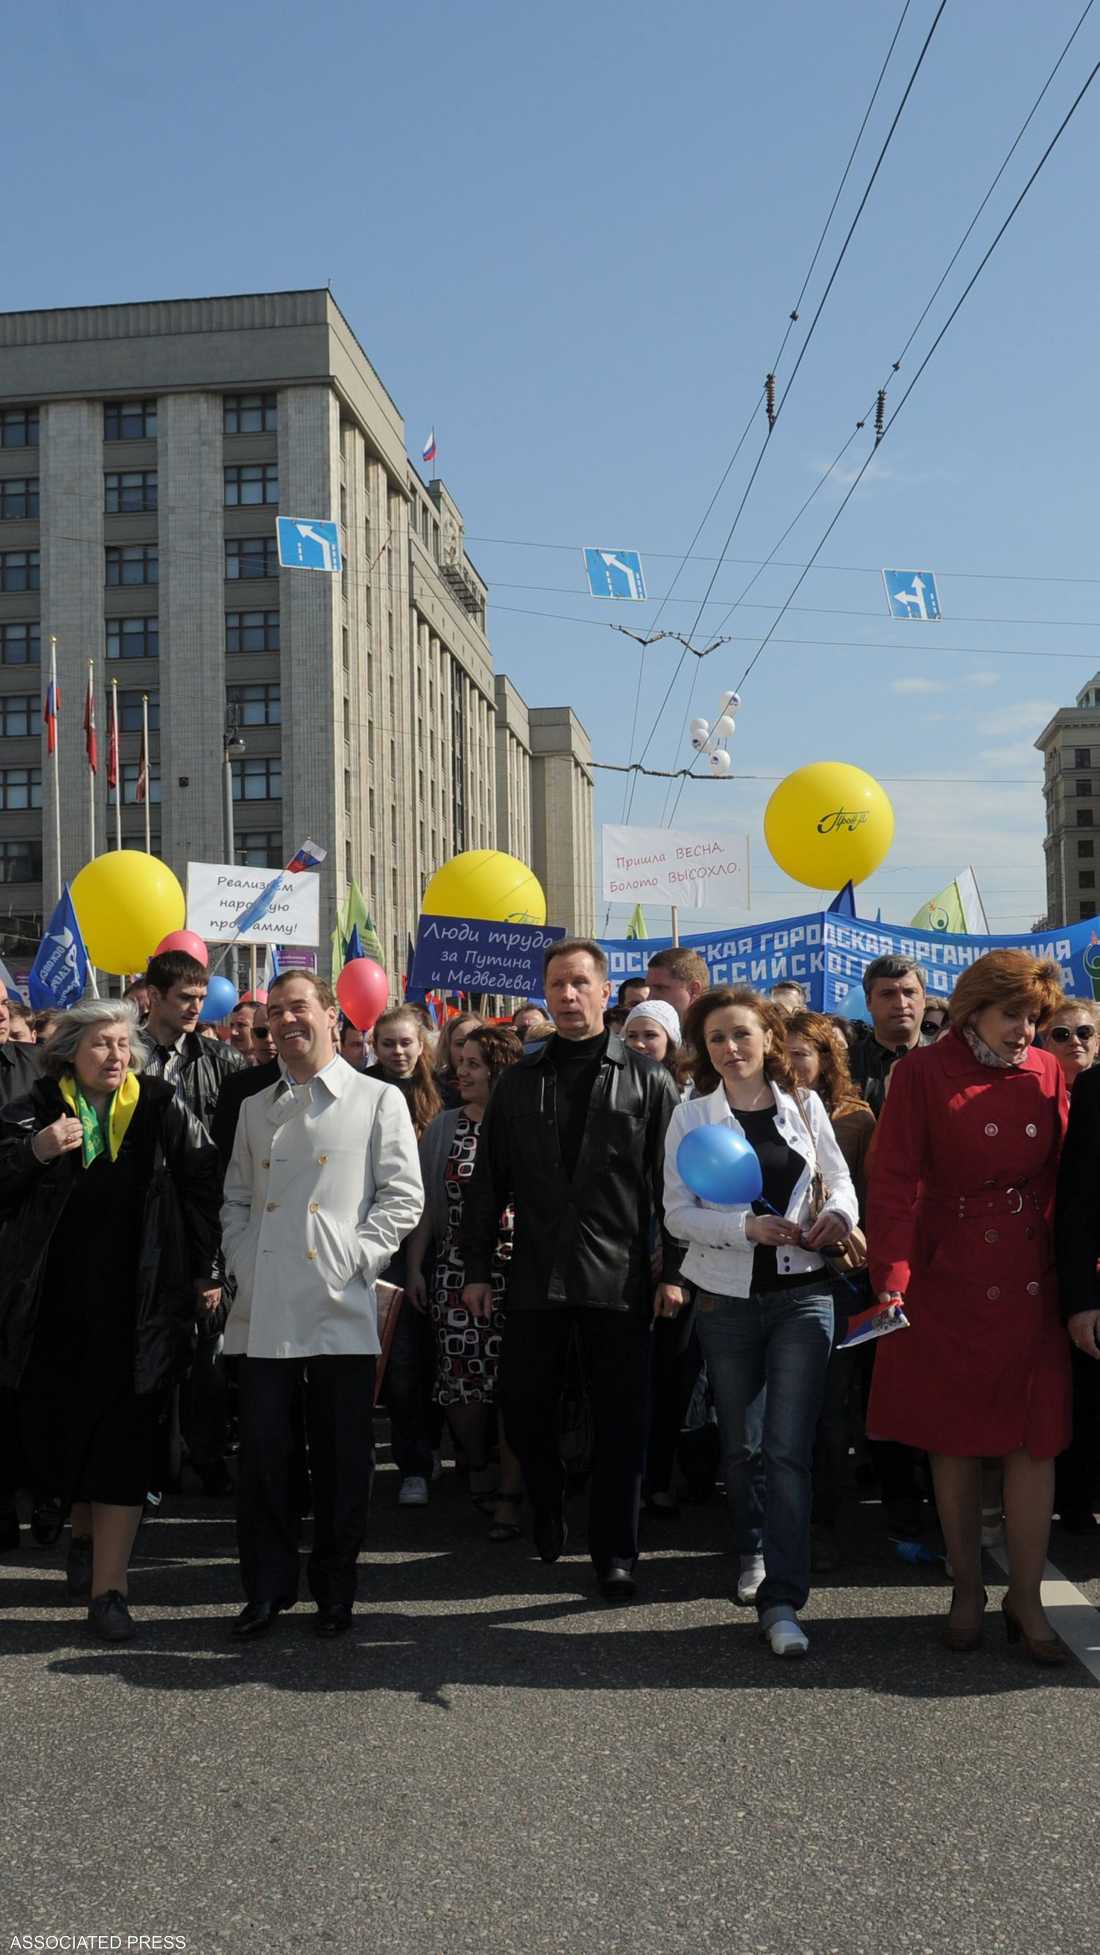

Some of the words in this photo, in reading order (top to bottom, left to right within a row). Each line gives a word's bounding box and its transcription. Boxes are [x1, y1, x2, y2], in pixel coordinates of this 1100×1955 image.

[616, 854, 666, 870] Пришла
[217, 876, 293, 892] Реализм
[610, 878, 658, 893] Болото
[219, 900, 290, 914] нароую
[210, 919, 298, 936] проамму!
[423, 922, 479, 942] Люди
[440, 951, 457, 962] за
[465, 951, 531, 969] Путина
[431, 971, 440, 982] и
[447, 970, 537, 991] Медведева!
